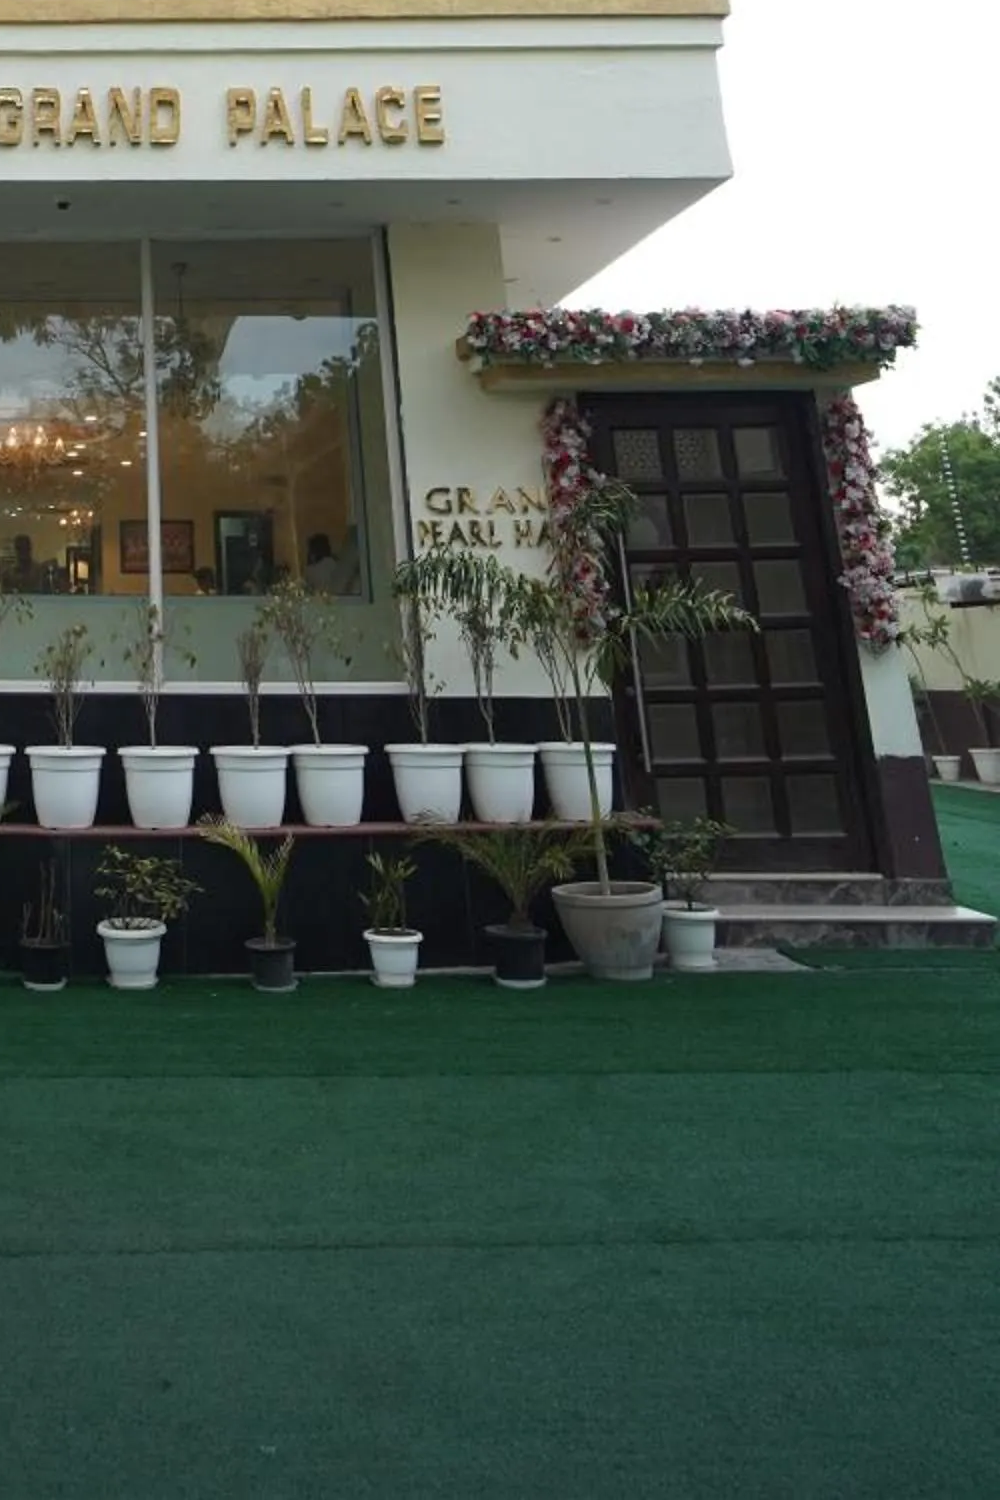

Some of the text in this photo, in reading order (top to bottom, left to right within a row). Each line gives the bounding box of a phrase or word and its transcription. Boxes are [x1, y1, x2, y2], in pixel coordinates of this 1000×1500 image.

[226, 85, 445, 147] PALACE
[425, 485, 549, 515] GRAN
[417, 519, 552, 548] PEARL HA
